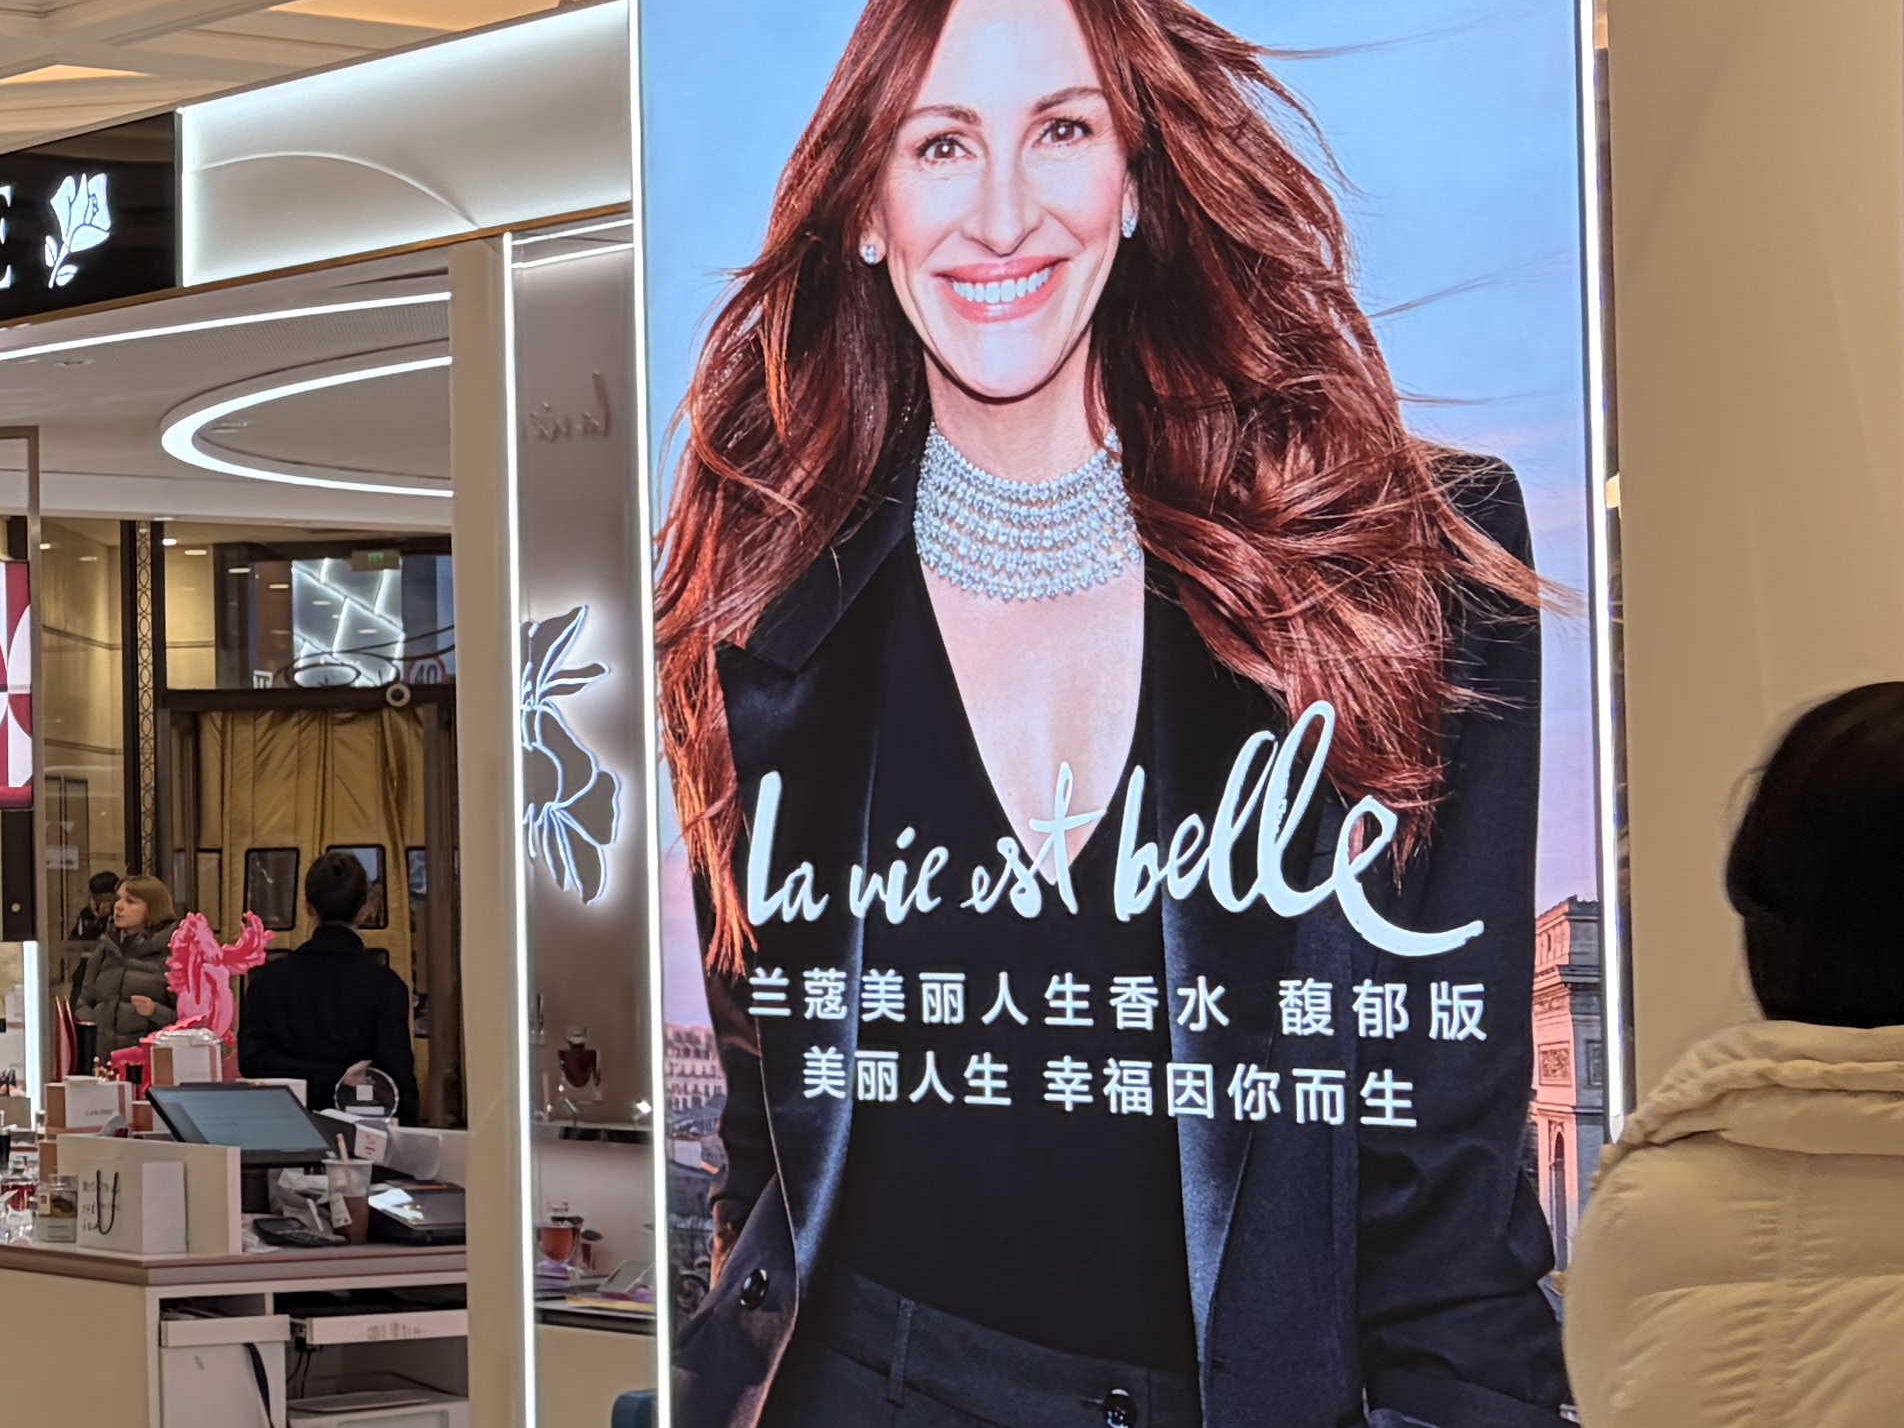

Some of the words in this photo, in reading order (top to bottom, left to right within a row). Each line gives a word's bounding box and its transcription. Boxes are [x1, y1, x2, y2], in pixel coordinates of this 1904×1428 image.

[744, 769, 830, 929] La
[848, 826, 949, 926] vie
[960, 760, 1108, 924] est
[1114, 699, 1486, 959] belle
[747, 964, 1231, 1035] 兰蔻美丽人生香水
[1278, 976, 1490, 1043] 馥郁版
[802, 1044, 1014, 1109] 美丽人生
[1042, 1058, 1420, 1130] 幸福因你而生
